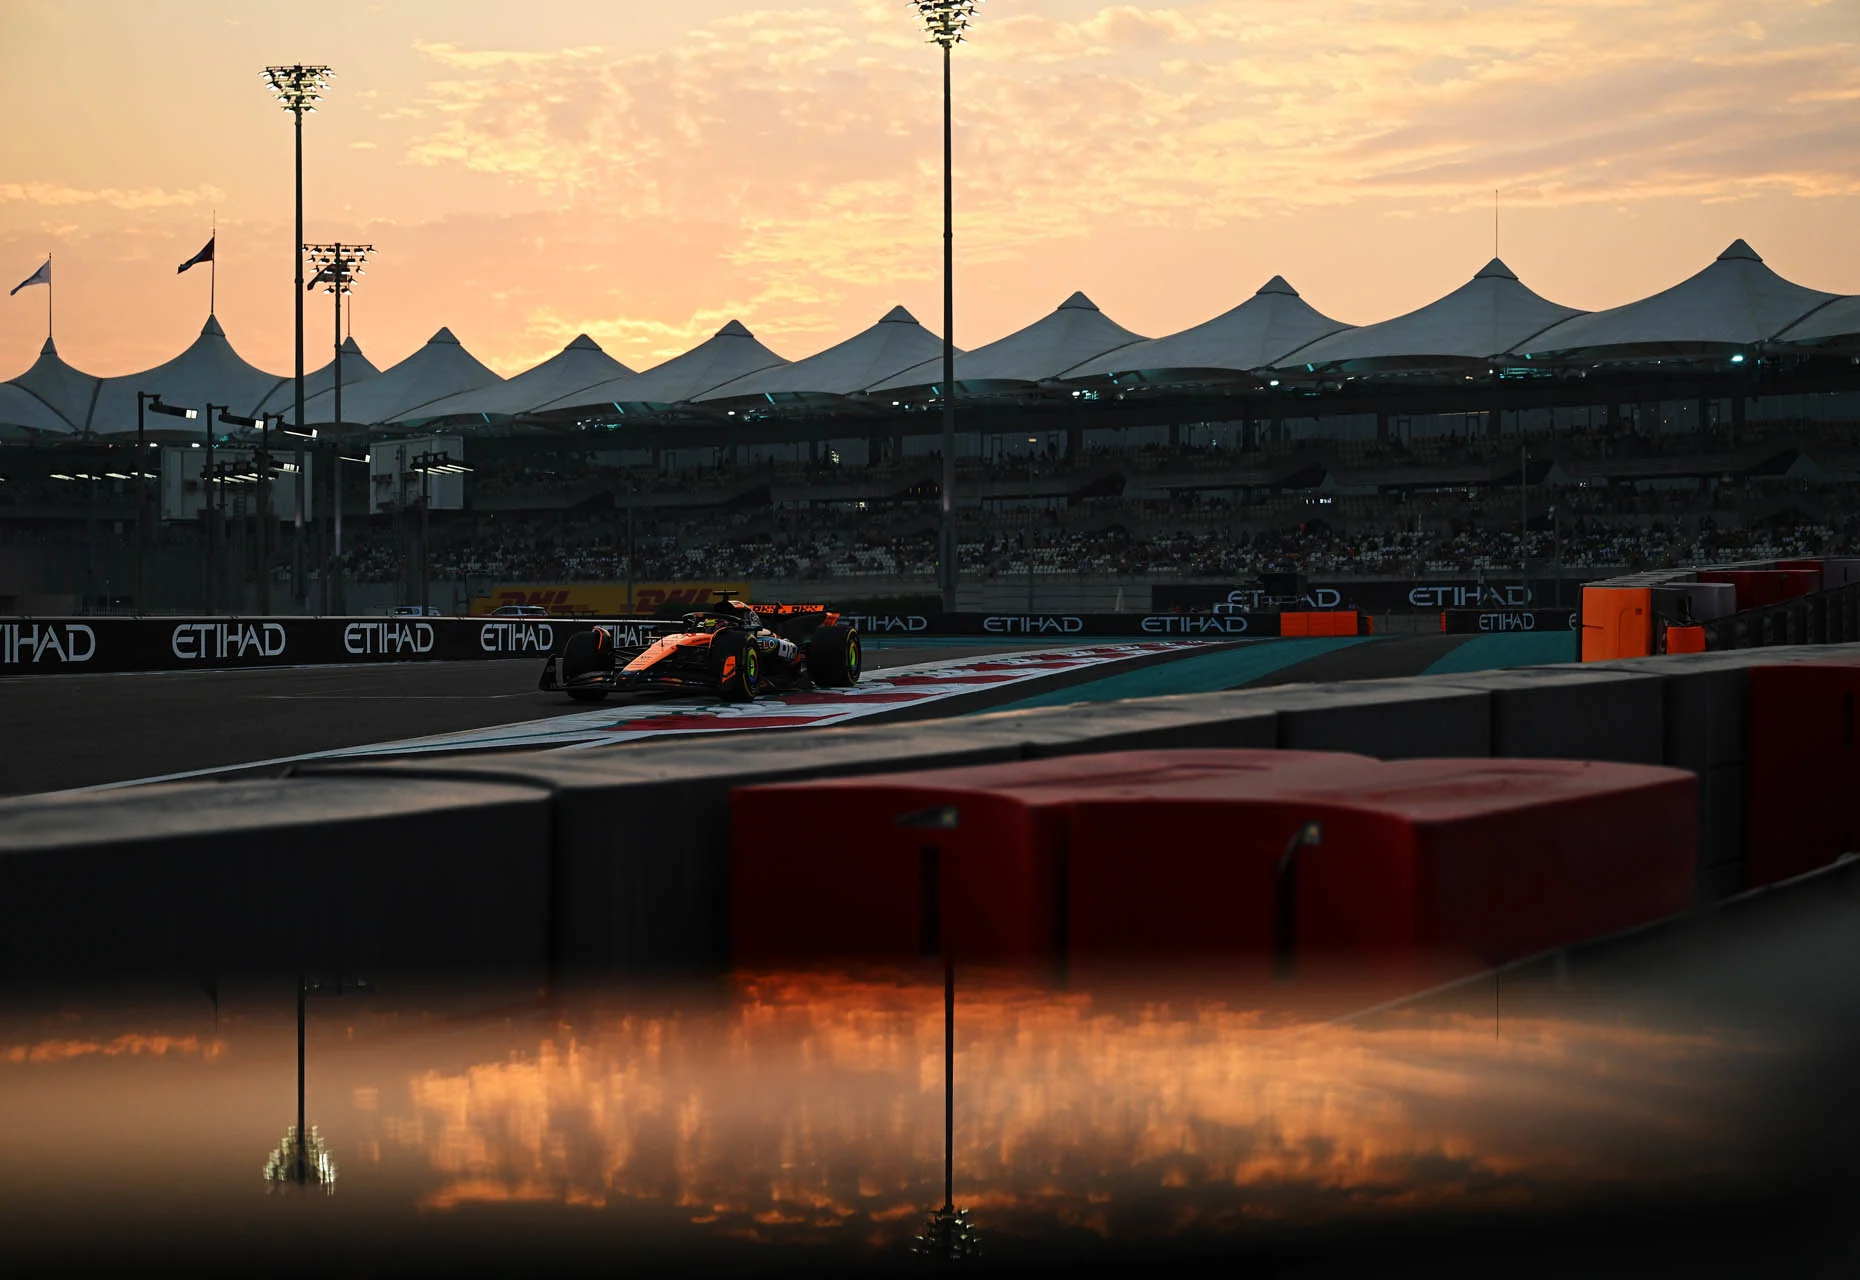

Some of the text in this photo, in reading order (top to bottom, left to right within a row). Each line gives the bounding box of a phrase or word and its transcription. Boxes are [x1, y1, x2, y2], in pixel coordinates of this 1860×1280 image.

[498, 591, 571, 612] DHL
[635, 588, 713, 612] DHL
[1408, 586, 1533, 607] ETIHAD
[983, 616, 1083, 632] ETIHAD
[1141, 616, 1248, 632] ETIHAD
[1479, 612, 1535, 631] ETIHAD
[0, 624, 96, 663] IHAD
[172, 623, 286, 659] ETIHAD
[344, 622, 434, 654] ETIHAD
[480, 622, 555, 652] ETIHAD
